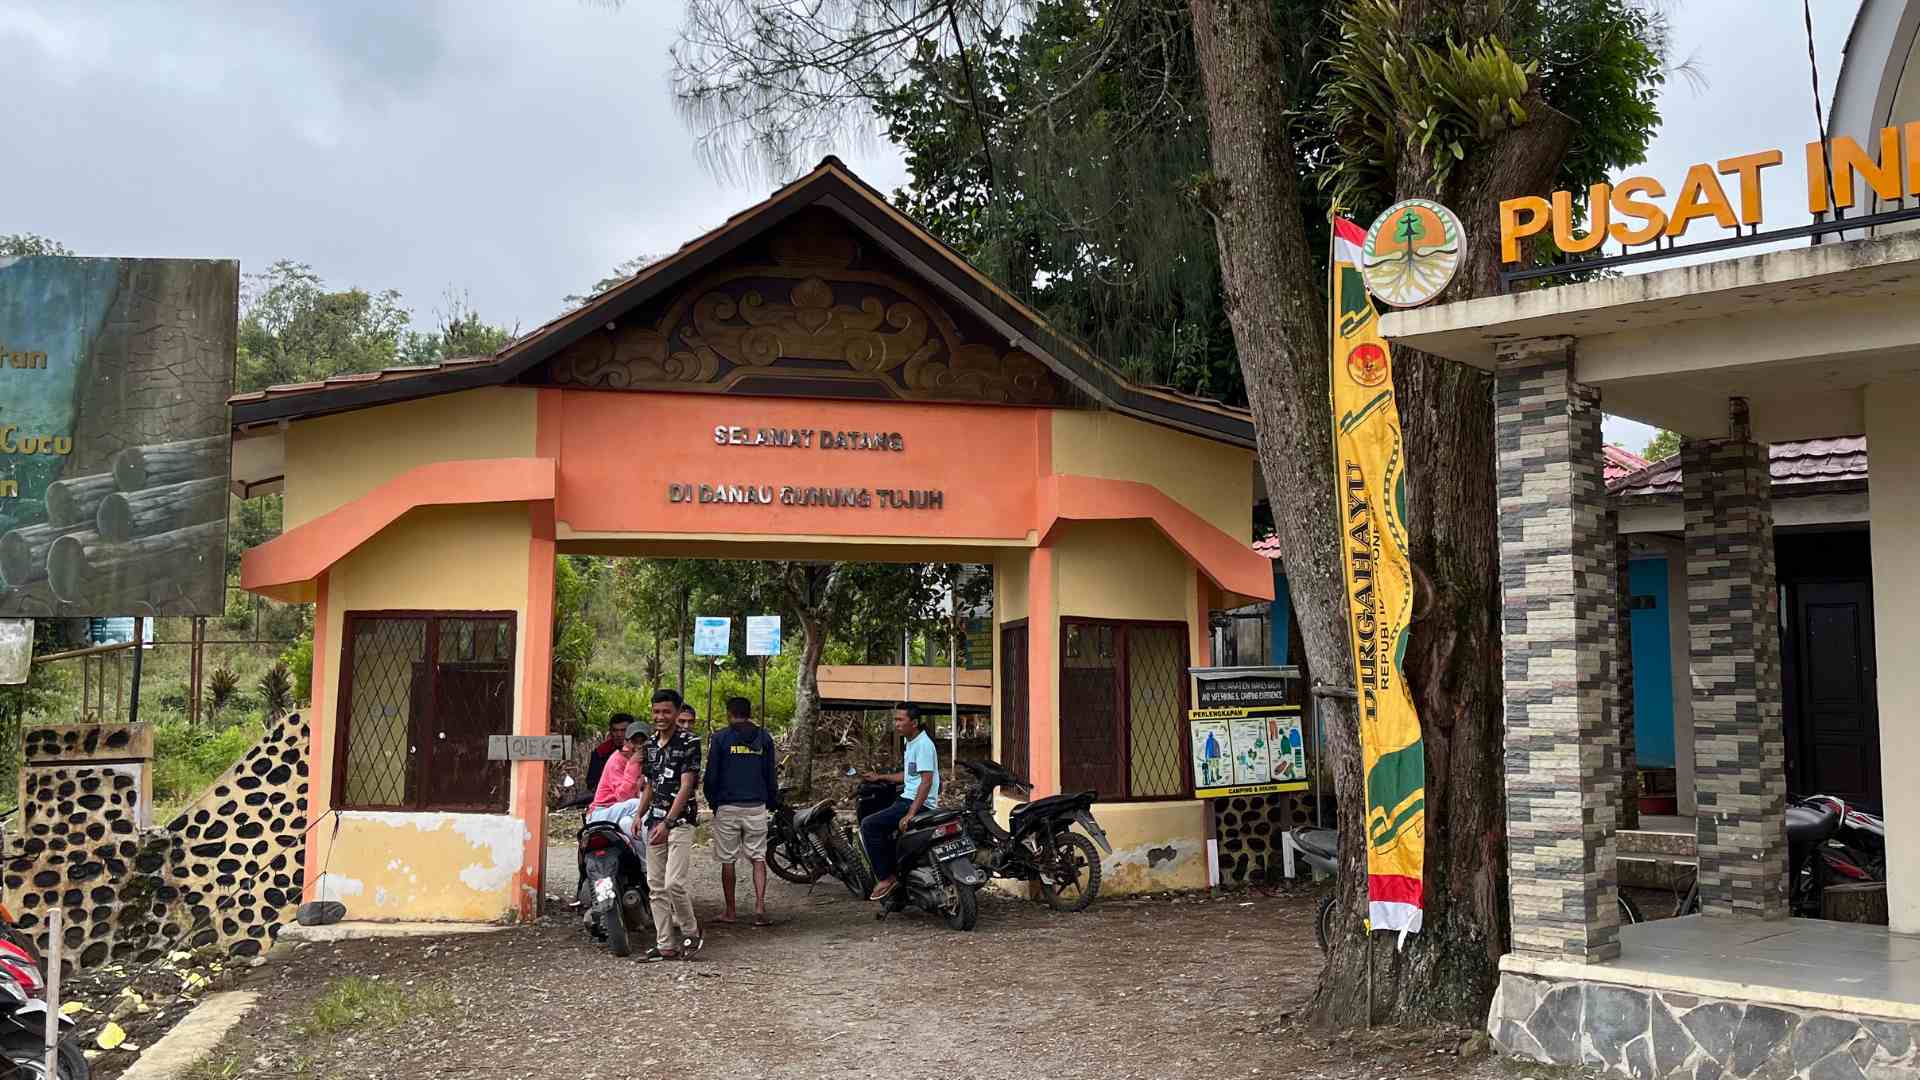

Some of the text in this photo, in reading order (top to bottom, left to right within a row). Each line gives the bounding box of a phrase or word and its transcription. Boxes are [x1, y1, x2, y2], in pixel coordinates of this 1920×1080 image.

[1499, 148, 1784, 264] PUSAT
[713, 425, 905, 452] SELAMAT DATANG
[668, 483, 944, 510] DI DANAU GUNUNG TUJUH
[1346, 459, 1378, 721] DIRGAHAYU
